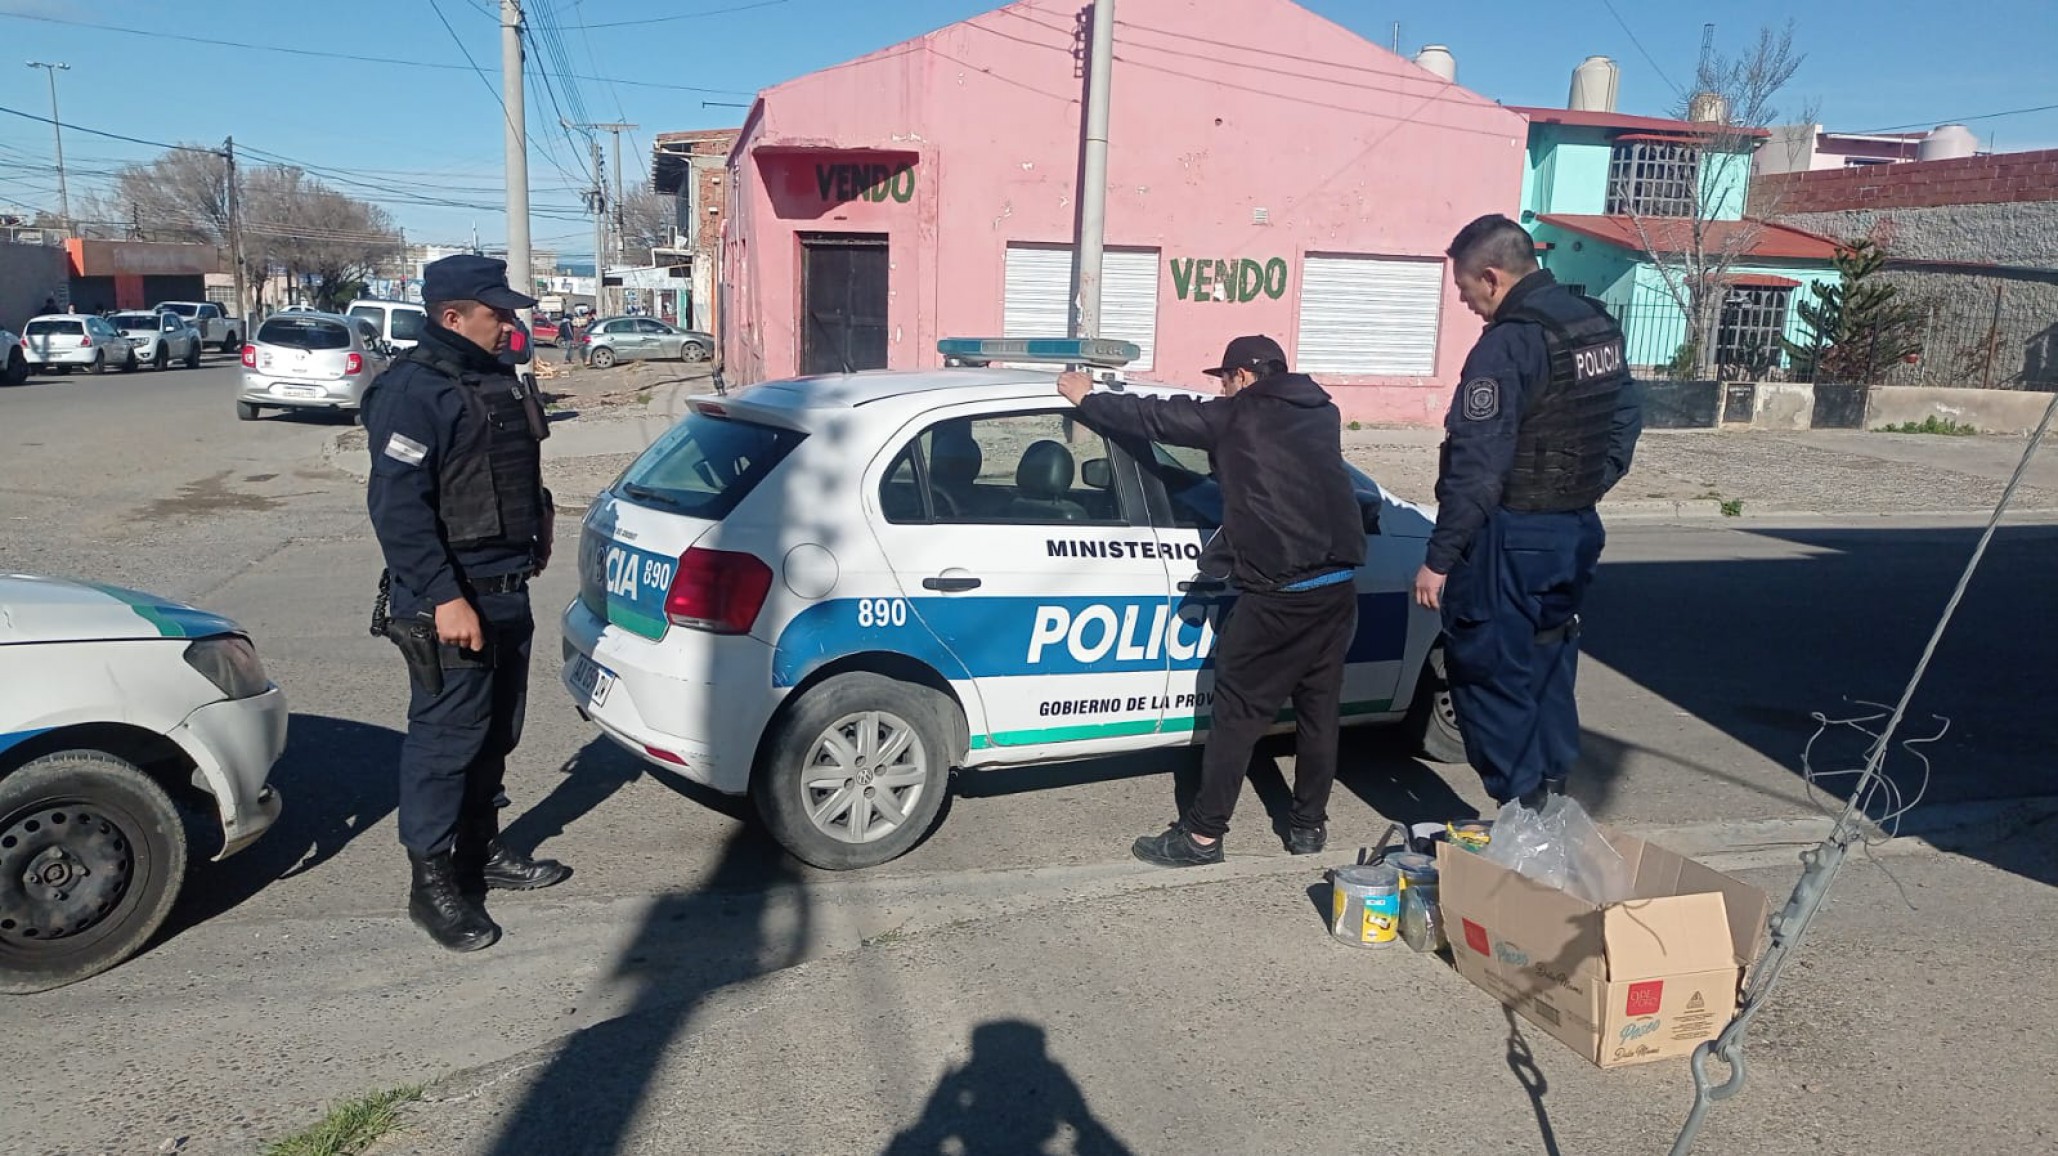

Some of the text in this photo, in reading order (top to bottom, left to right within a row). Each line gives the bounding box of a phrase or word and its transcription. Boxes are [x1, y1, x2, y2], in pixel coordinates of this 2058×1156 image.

[815, 162, 915, 204] VENDO
[1169, 257, 1287, 303] VENDO
[1575, 345, 1621, 381] POLICIA
[1046, 539, 1201, 561] MINISTERIO
[643, 559, 671, 591] 890
[858, 598, 907, 628] 890
[1039, 698, 1121, 717] GOBIERNO
[1126, 696, 1147, 711] DE
[1151, 695, 1170, 709] LA
